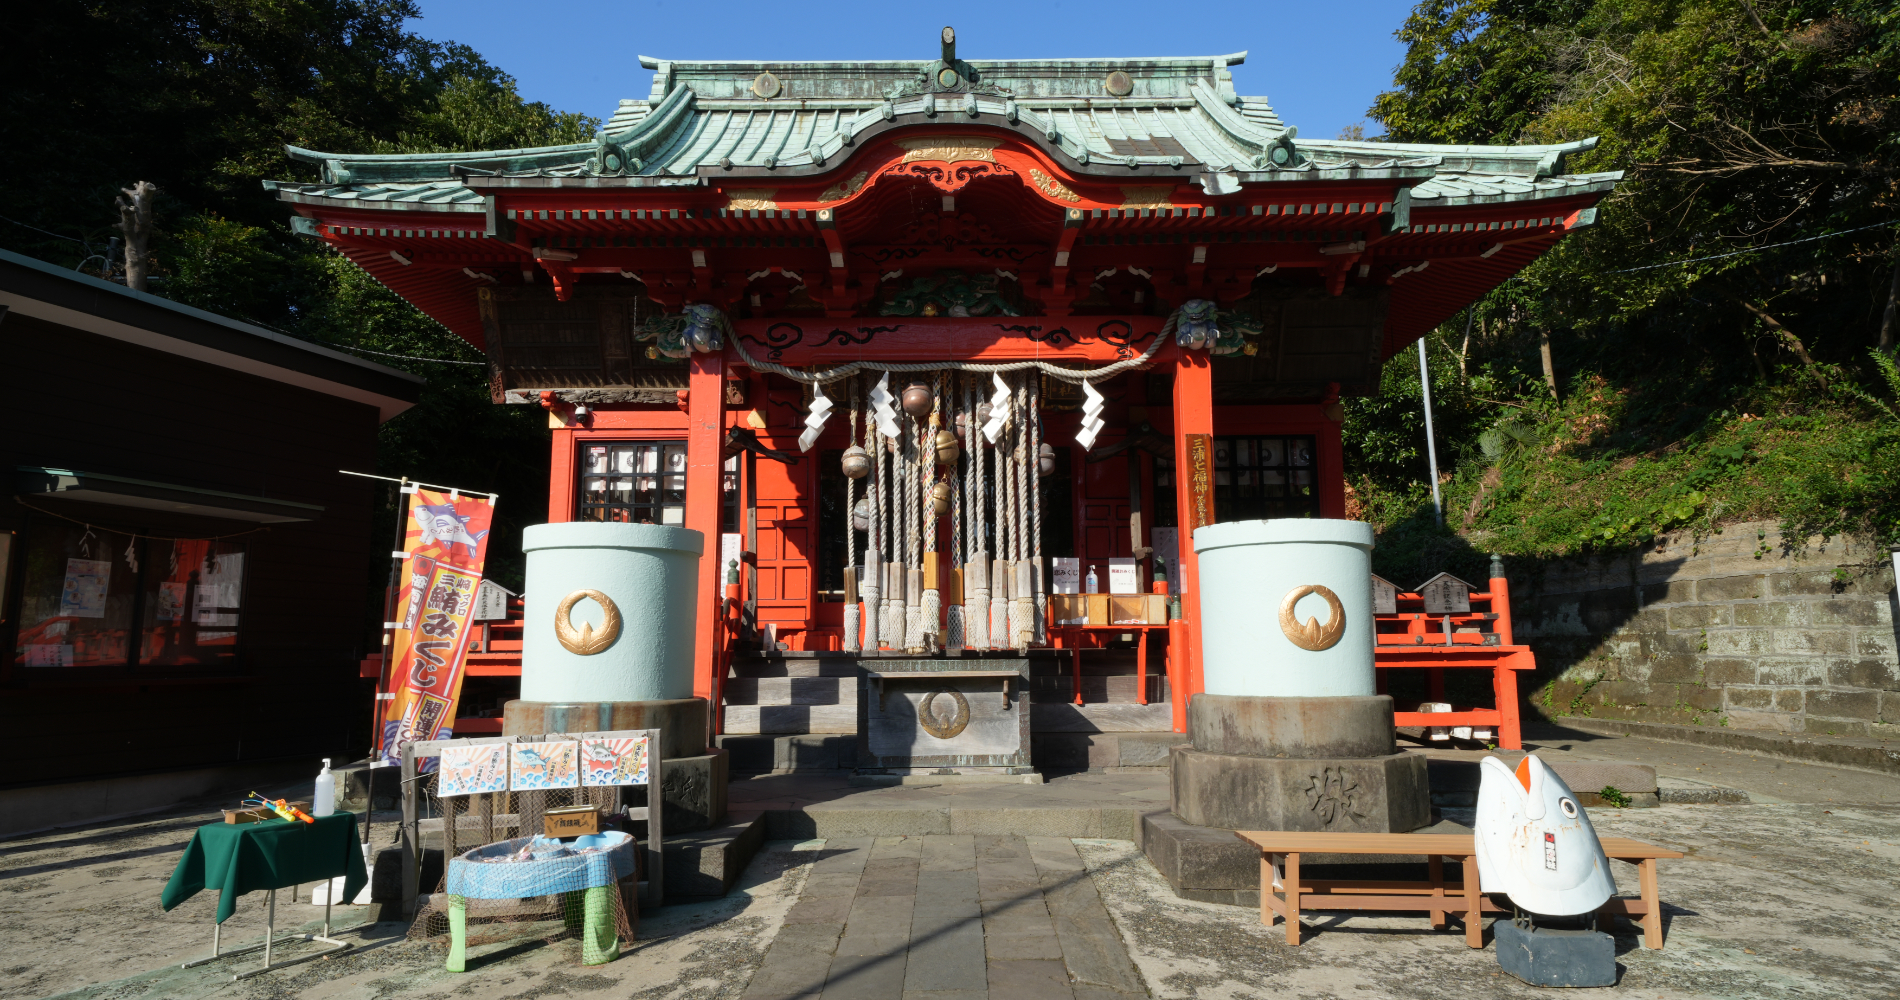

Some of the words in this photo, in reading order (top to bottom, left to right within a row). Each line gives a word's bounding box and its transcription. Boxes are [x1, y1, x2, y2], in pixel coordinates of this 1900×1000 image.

[1192, 438, 1208, 494] 三浦七福神
[411, 584, 459, 687] 鮪みくじ
